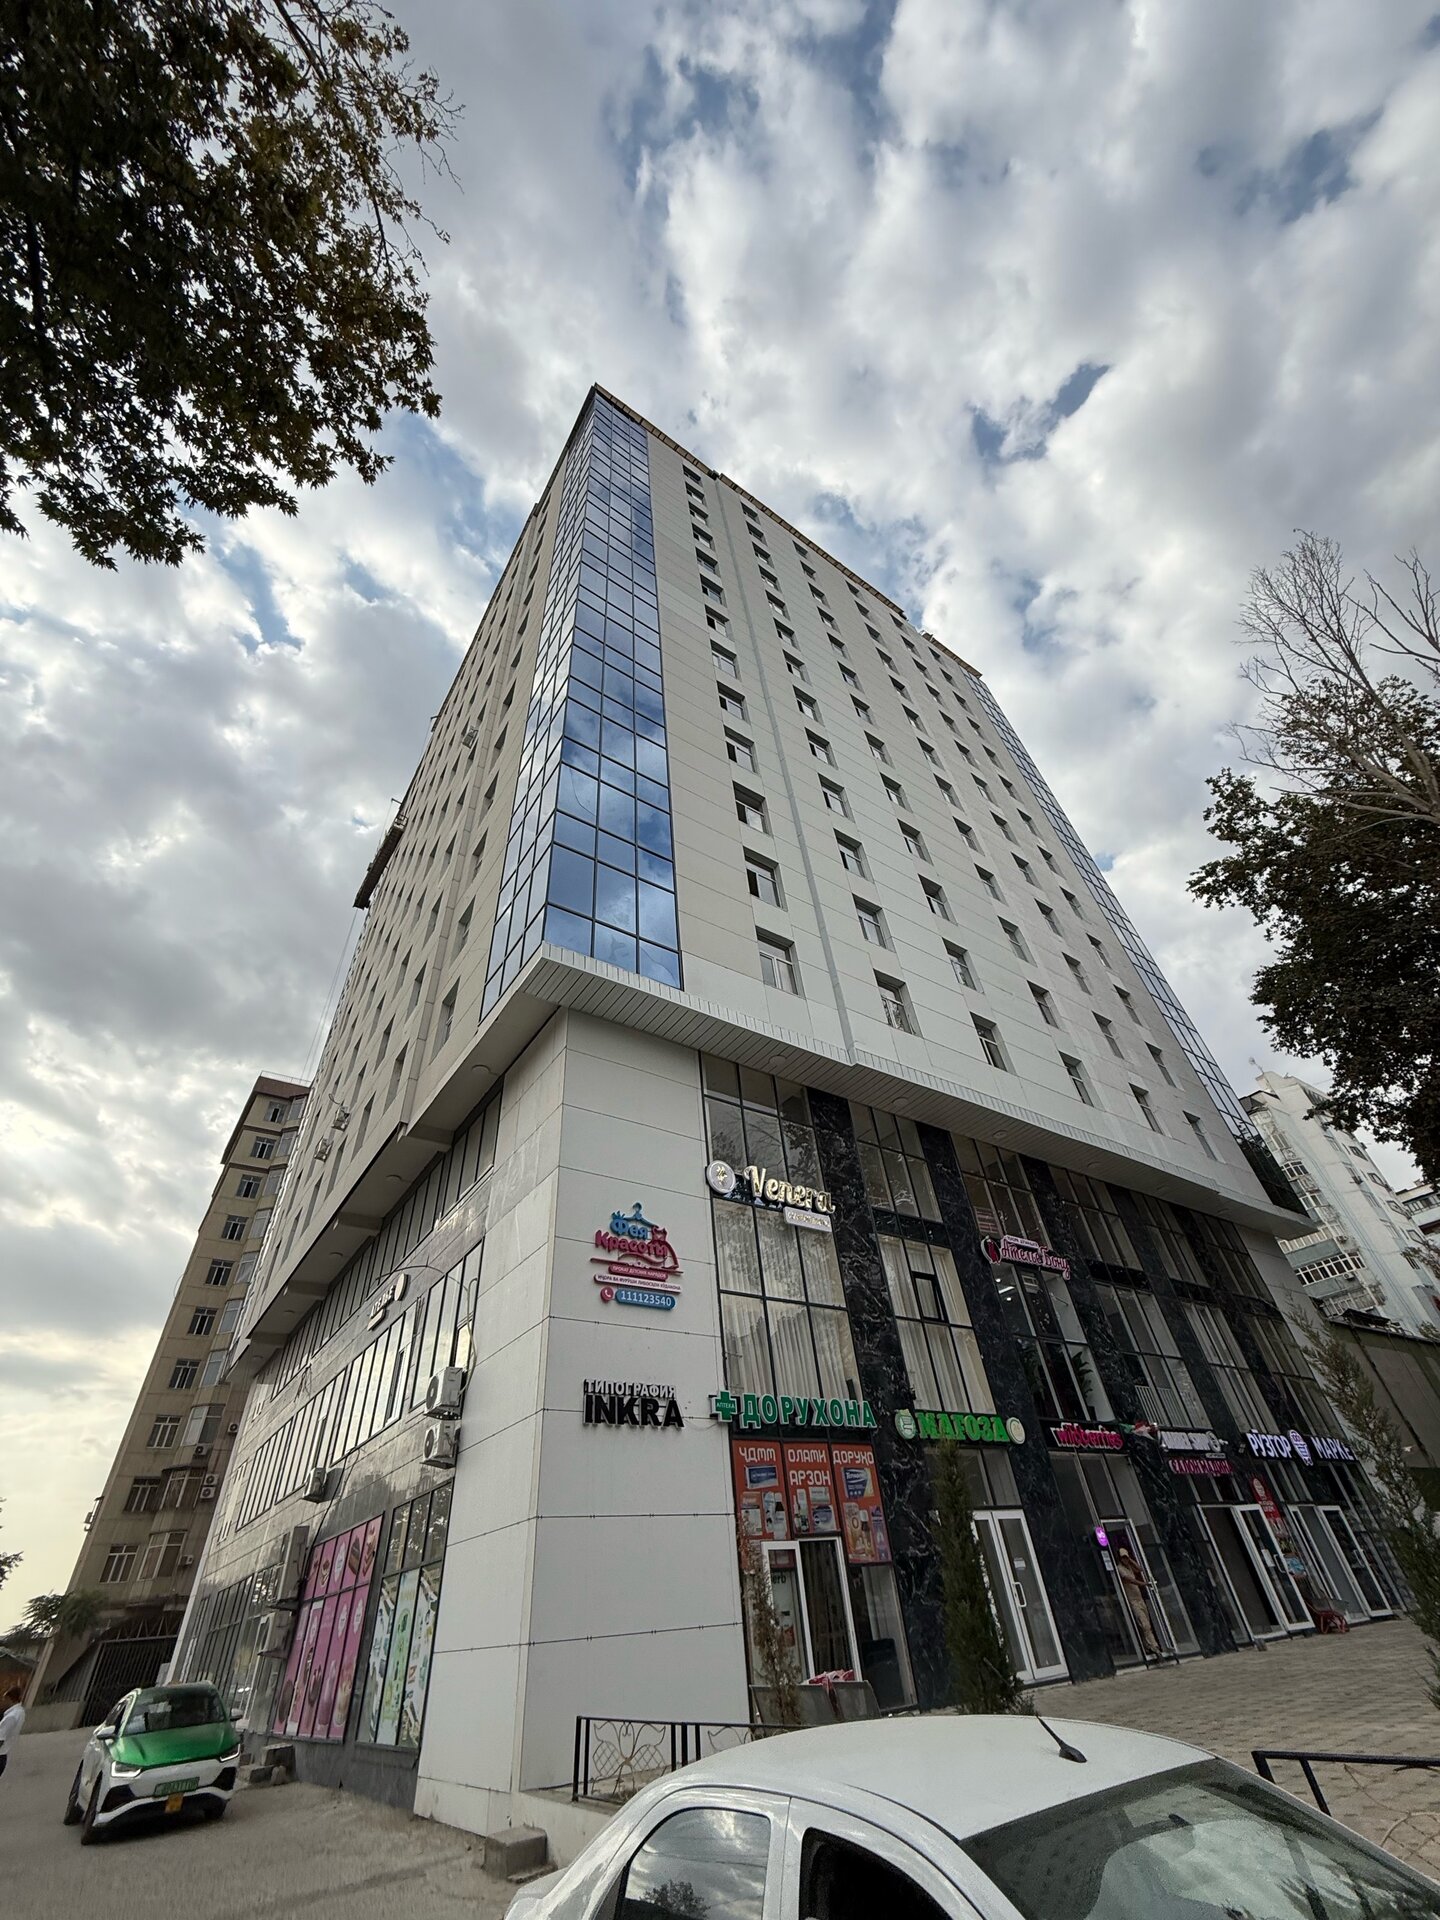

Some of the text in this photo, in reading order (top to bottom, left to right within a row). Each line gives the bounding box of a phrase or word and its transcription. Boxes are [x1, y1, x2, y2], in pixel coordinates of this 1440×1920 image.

[743, 1165, 836, 1214] Venera
[610, 1216, 648, 1240] Фея
[595, 1230, 668, 1257] Красоты
[620, 1290, 672, 1306] 111123540
[584, 1379, 677, 1398] ТИПОГРАФИЯ
[583, 1394, 685, 1428] INKRA
[716, 1402, 736, 1410] АПТЕКА
[740, 1392, 878, 1429] ДОРУХОНА
[1050, 1421, 1124, 1450] wildberries
[789, 1470, 831, 1486] АРЗОН
